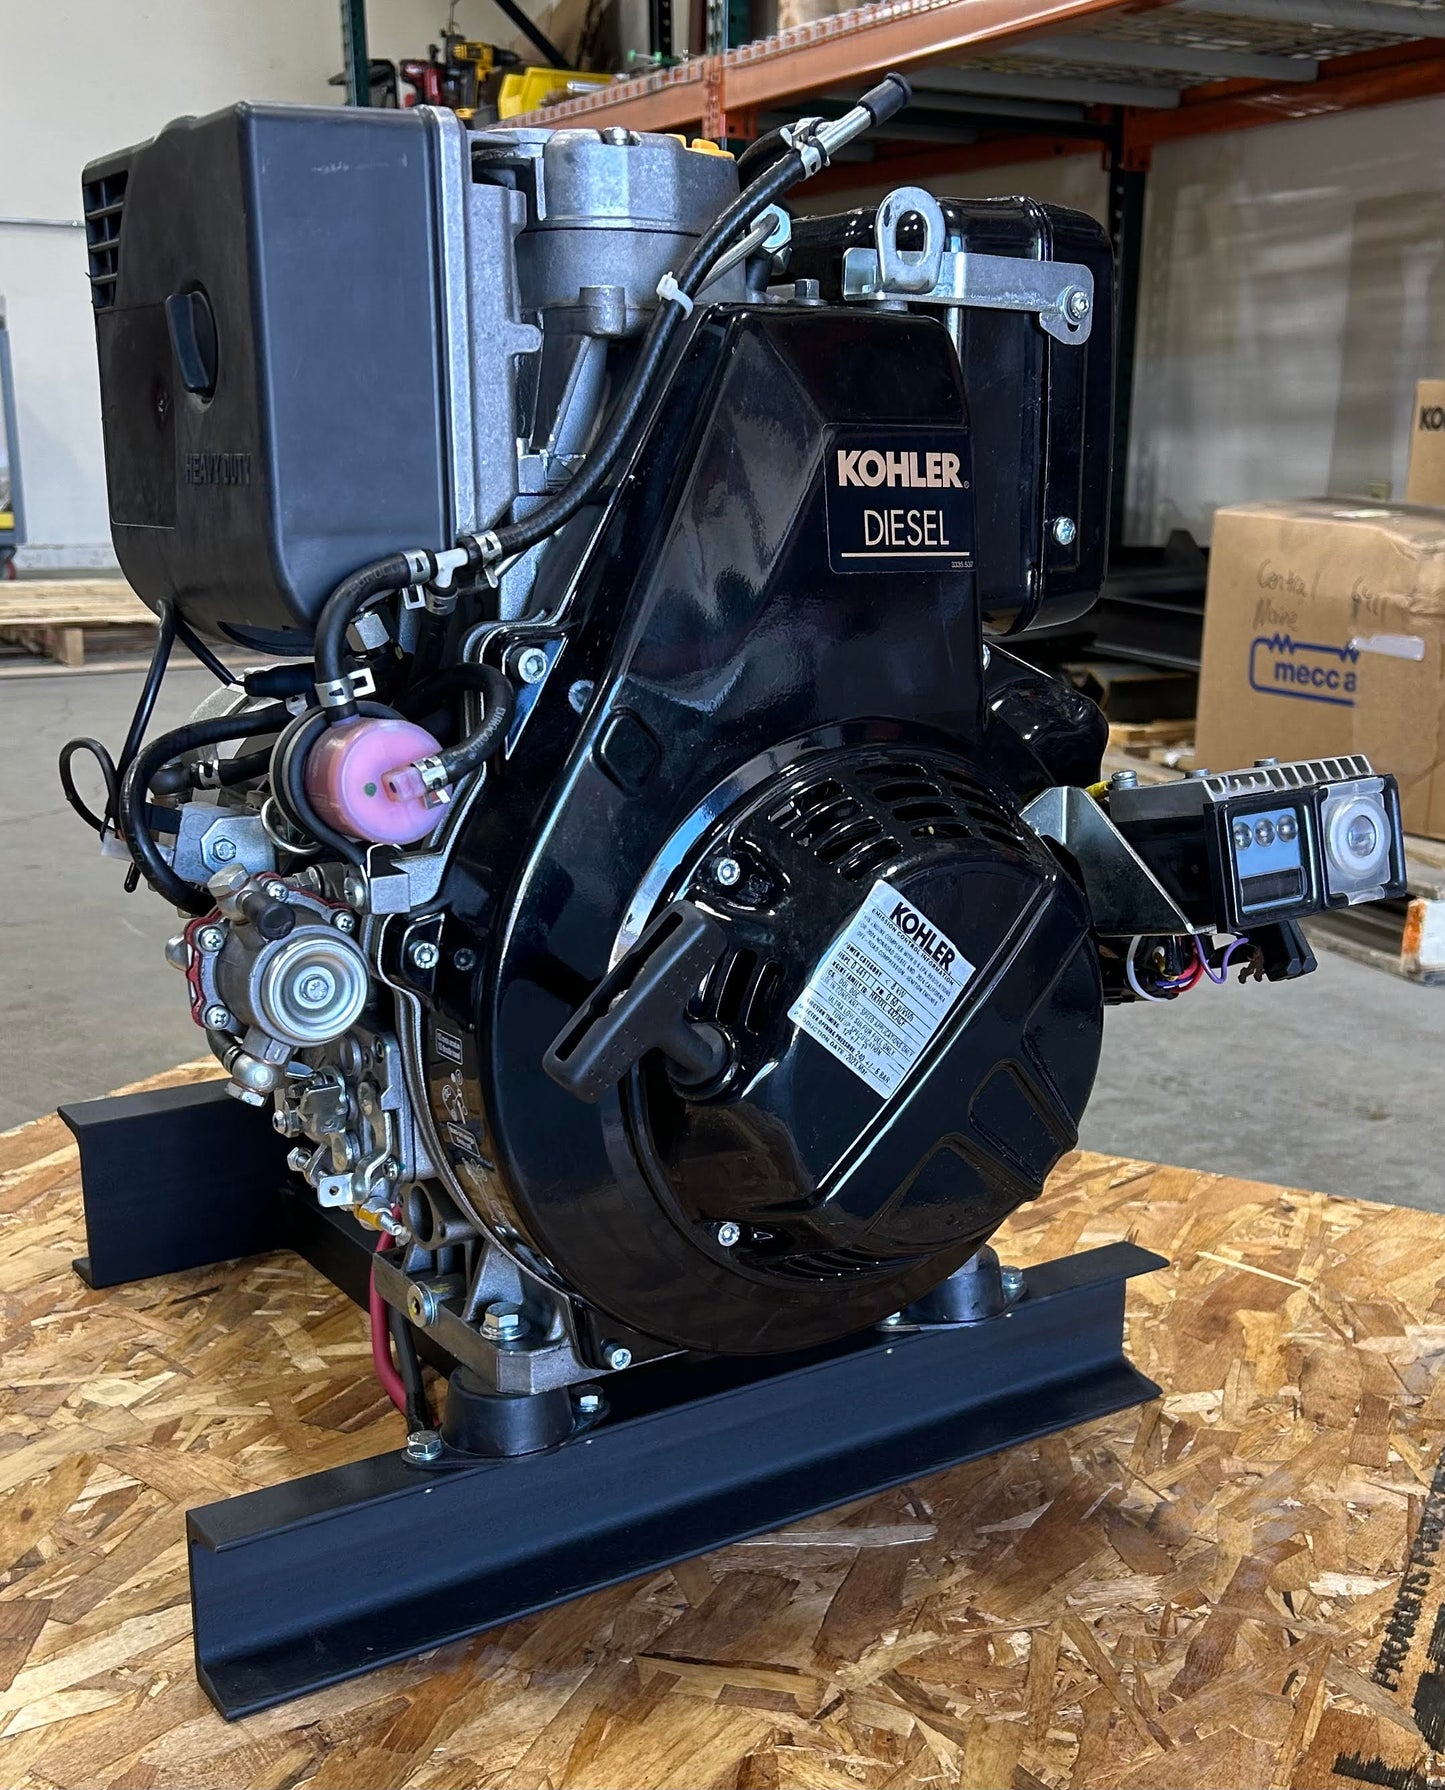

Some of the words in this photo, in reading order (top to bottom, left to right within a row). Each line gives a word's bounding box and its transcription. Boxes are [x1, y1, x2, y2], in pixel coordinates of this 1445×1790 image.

[1420, 405, 1445, 431] KO
[184, 452, 221, 486] HEAVY
[223, 452, 252, 486] DUTY
[837, 450, 963, 488] KOHLER
[863, 509, 950, 546] DIESEL
[871, 907, 897, 933] EMISSION
[896, 930, 921, 954] CONTROL
[919, 952, 954, 985] INFORMATION
[888, 901, 958, 971] KOHLER
[793, 1009, 830, 1043] PRODUCTION
